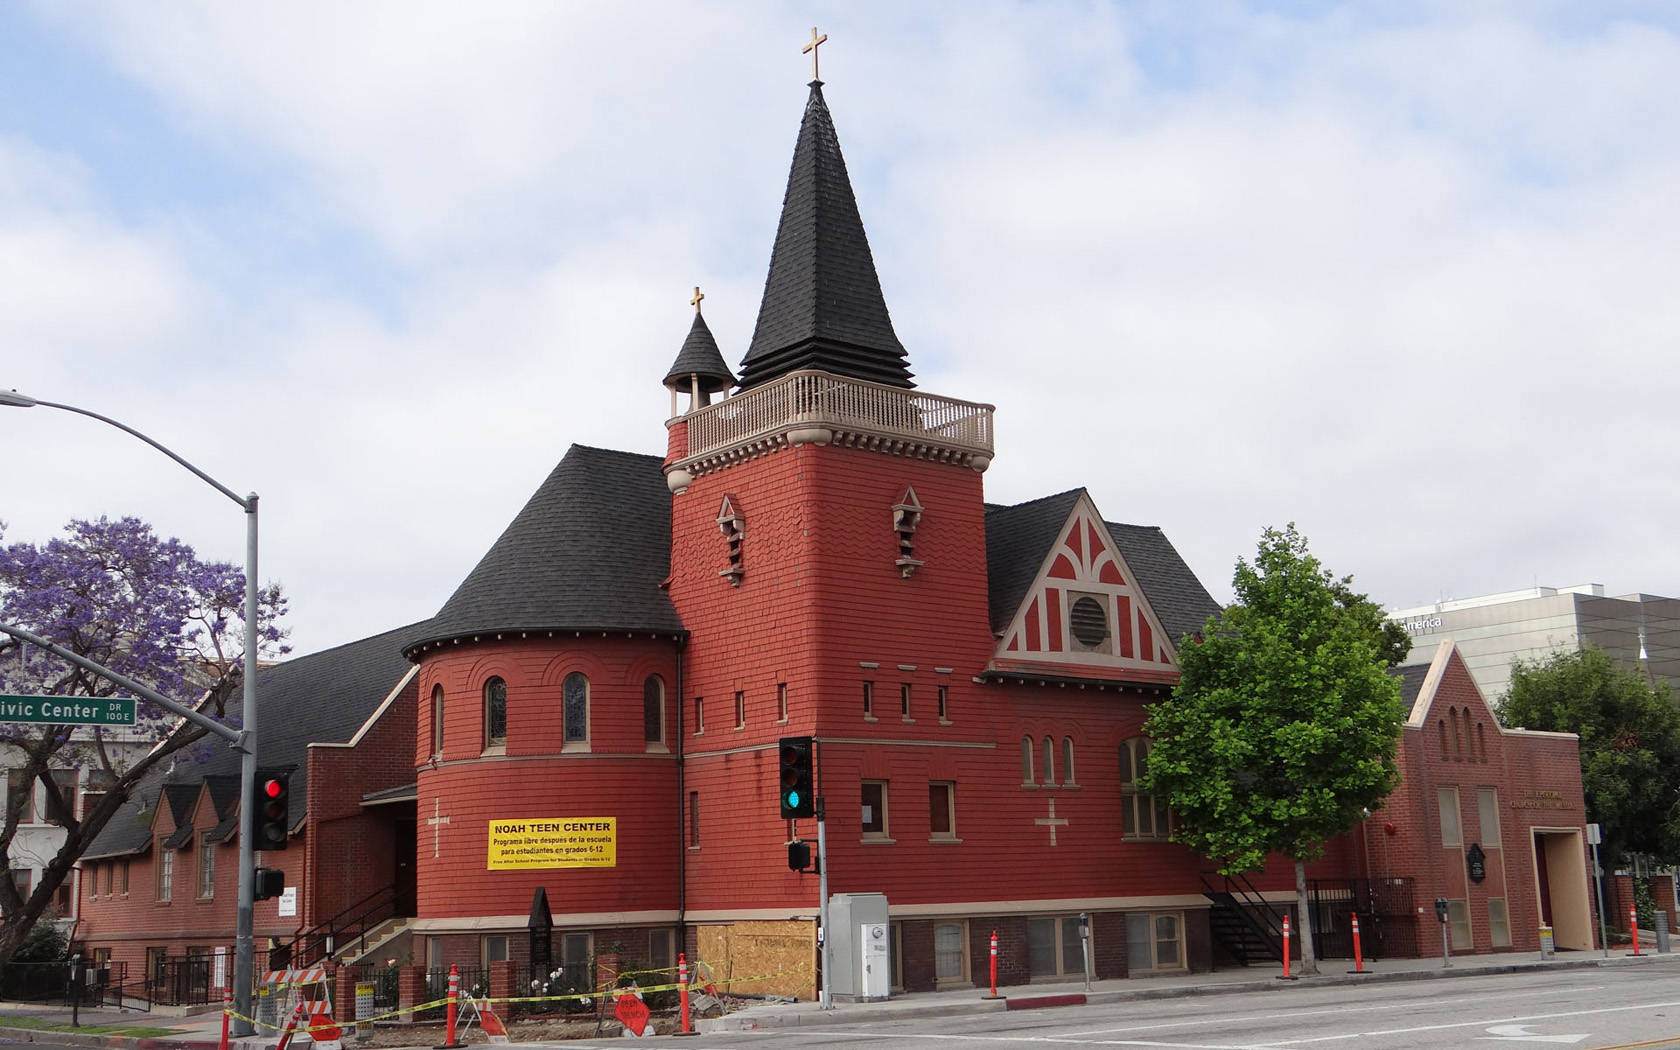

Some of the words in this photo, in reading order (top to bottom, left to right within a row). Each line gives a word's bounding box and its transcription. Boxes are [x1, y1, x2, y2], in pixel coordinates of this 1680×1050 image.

[0, 701, 33, 716] ivic
[41, 702, 99, 718] Center
[109, 703, 121, 711] DR
[495, 825, 526, 834] NOAH
[530, 823, 560, 832] TEEN
[563, 822, 611, 832] CENTER
[493, 838, 523, 847] Programa
[524, 837, 539, 845] libre
[579, 835, 585, 843] la
[586, 834, 612, 843] escuela
[516, 847, 554, 855] estudiantes
[565, 846, 588, 855] grados
[589, 845, 604, 853] 6-12
